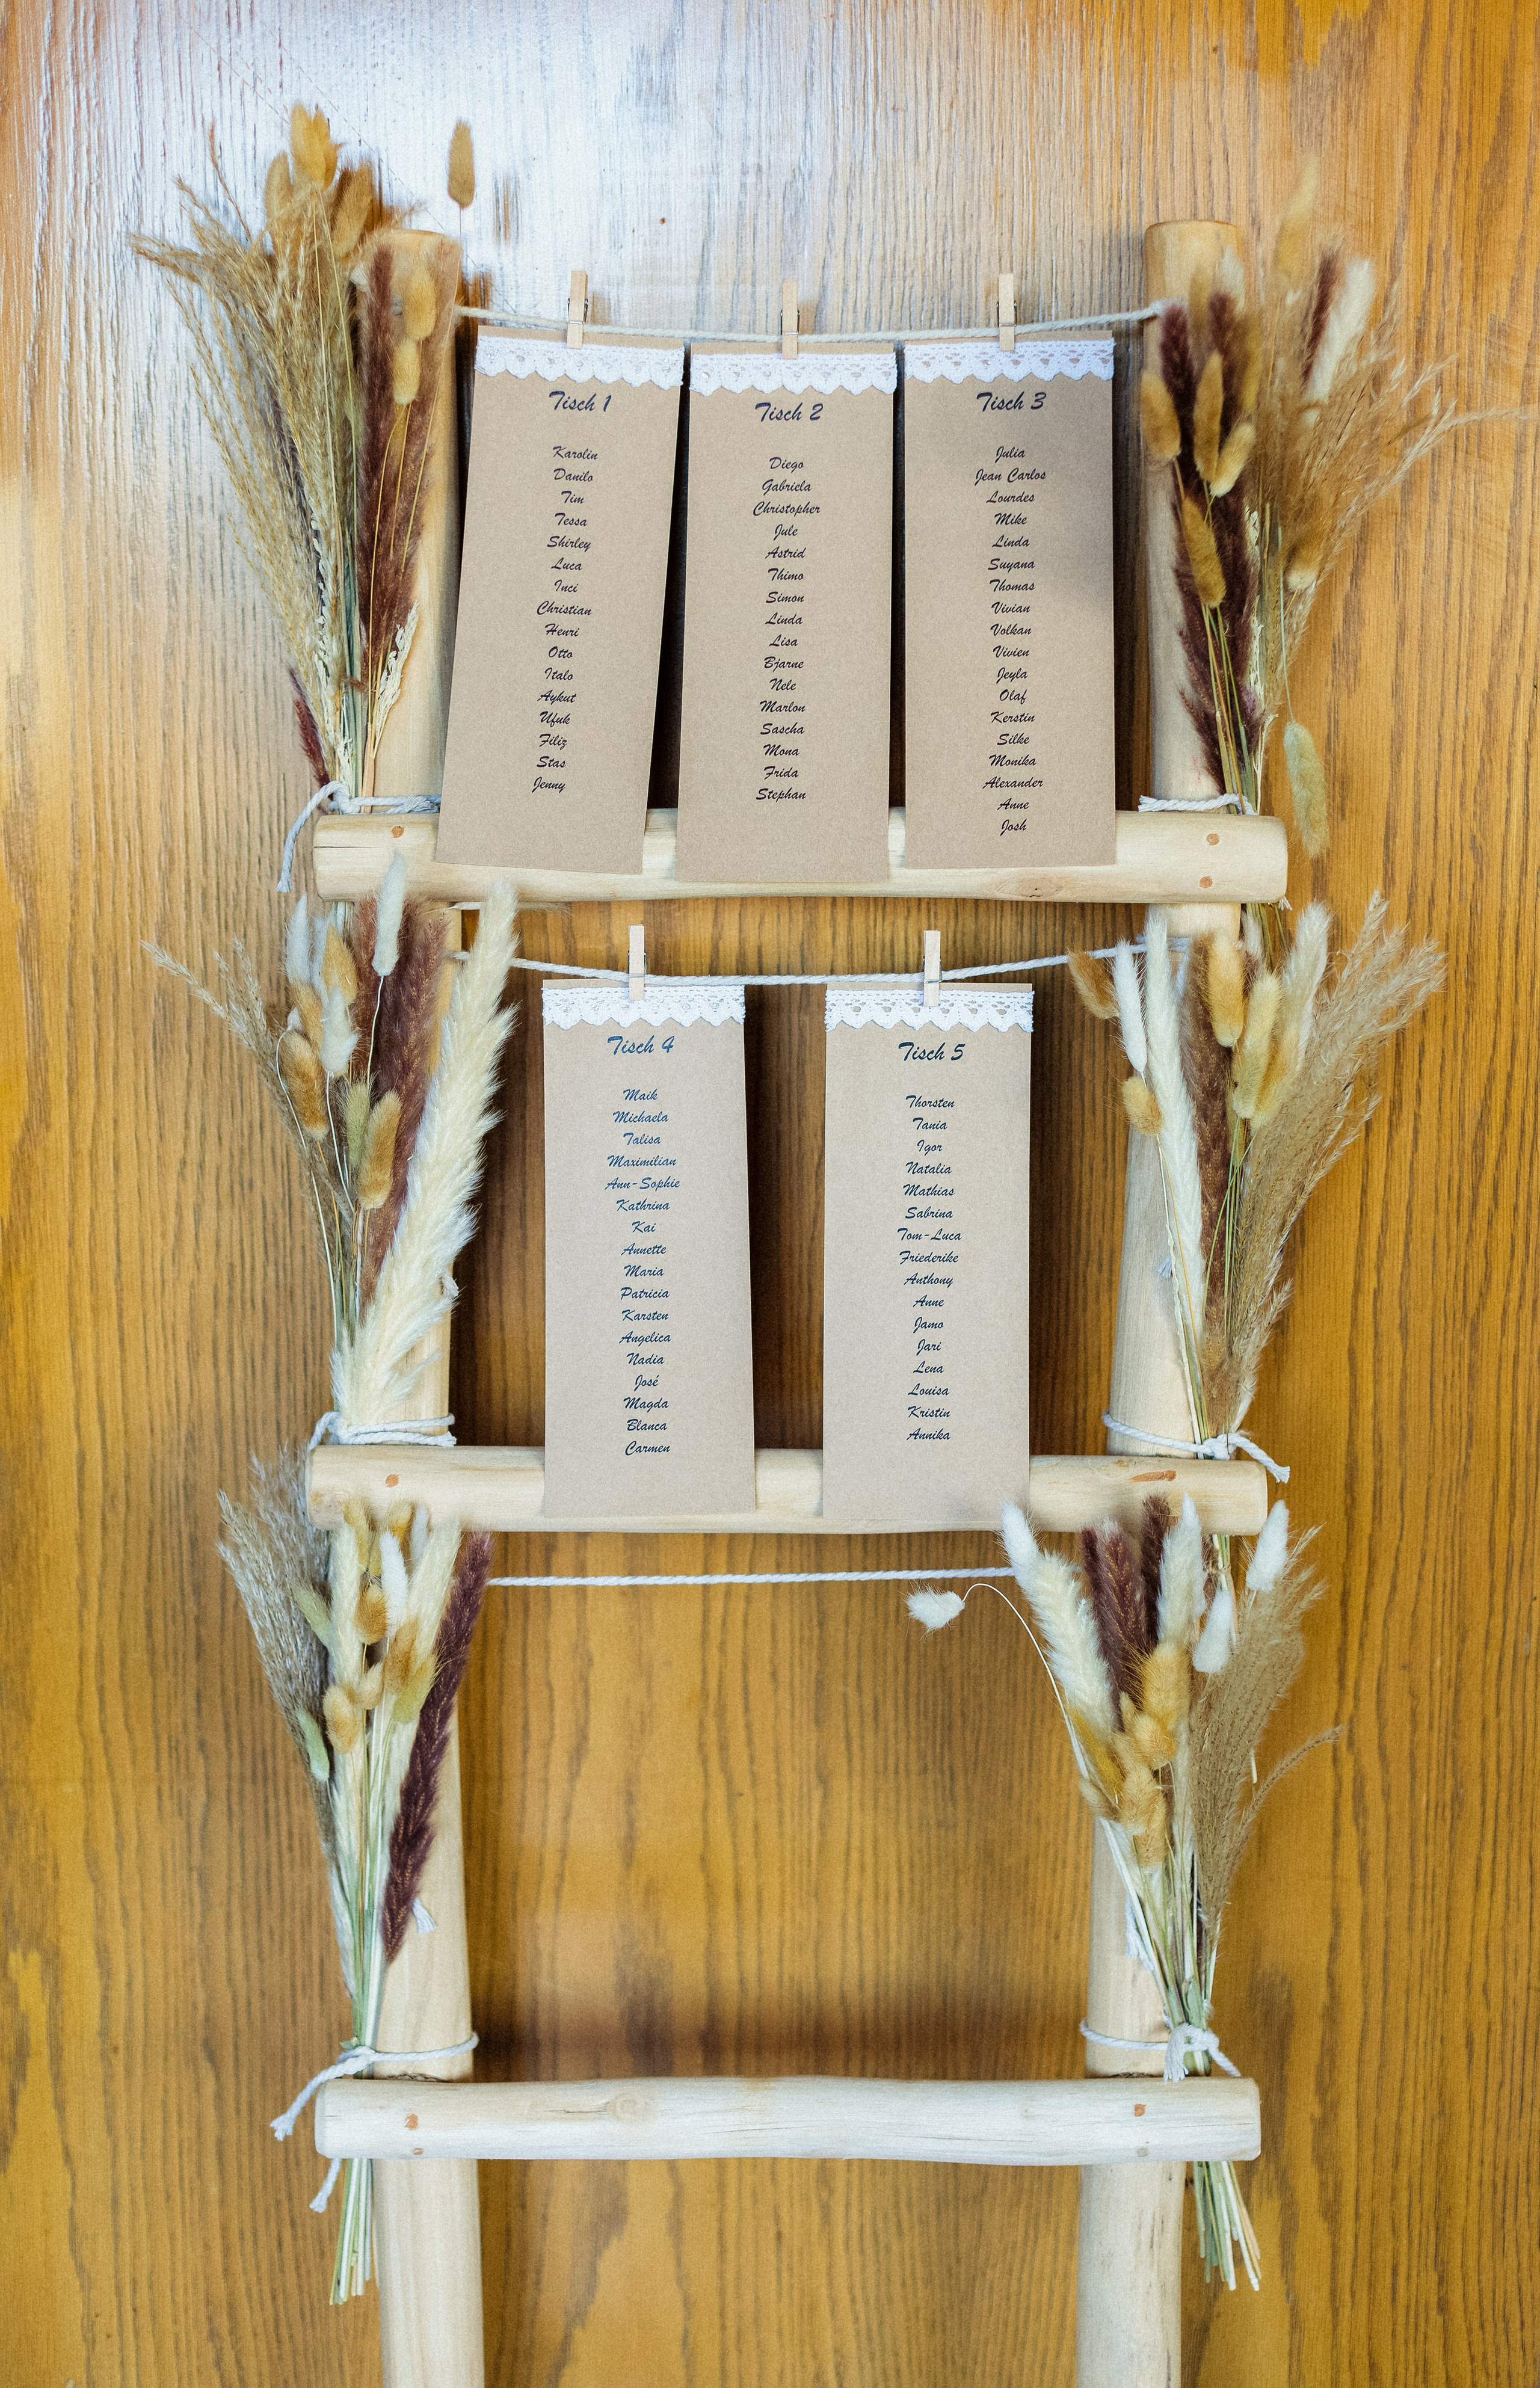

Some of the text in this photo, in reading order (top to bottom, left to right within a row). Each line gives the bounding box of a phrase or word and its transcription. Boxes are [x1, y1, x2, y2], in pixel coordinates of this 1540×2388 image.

[549, 390, 612, 413] Tisch 1
[976, 390, 1047, 413] Tisch 3
[754, 401, 824, 423] Tisch 2
[552, 445, 599, 461] Karolin
[994, 445, 1026, 464] Julia
[769, 456, 804, 474] Diego
[553, 467, 593, 482] Danilo
[974, 467, 1047, 487] Jean Carlos
[762, 478, 812, 496] Gabriela
[561, 490, 585, 505] Tim
[985, 490, 1035, 504] Lourdes
[753, 500, 821, 517] Christopher
[554, 512, 588, 527] Tessa
[994, 512, 1027, 526] Mike
[773, 523, 798, 541] Jule
[546, 535, 591, 553] Shirley
[991, 534, 1030, 548] Linda
[765, 546, 807, 559] Astrid
[550, 556, 583, 571] Luca
[987, 558, 1036, 573] Suyana
[767, 567, 805, 582] Thimo
[553, 579, 578, 593] Inci
[989, 579, 1036, 592] Thomas
[765, 591, 805, 604] Simon
[536, 600, 593, 616] Christian
[991, 601, 1030, 615] Vivian
[765, 612, 804, 626] Linda
[544, 623, 579, 637] Henri
[990, 623, 1032, 637] Volkan
[768, 633, 799, 647] Lisa
[548, 645, 573, 659] Otto
[992, 645, 1030, 659] Vivien
[763, 656, 804, 673] Bjarne
[544, 667, 574, 681] Italo
[996, 666, 1029, 685] Jeyla
[769, 677, 796, 692] Nele
[537, 689, 577, 706] Aykut
[999, 688, 1027, 706] Olaf
[759, 700, 806, 713] Marlon
[539, 710, 571, 728] Ufuk
[990, 710, 1036, 724] Kerstin
[760, 721, 805, 736] Sascha
[538, 733, 568, 751] Filiz
[996, 732, 1030, 746] Silke
[763, 743, 800, 757] Mona
[536, 755, 567, 768] Stas
[988, 754, 1037, 767] Monika
[763, 765, 799, 781] Frida
[531, 776, 566, 794] Jenny
[982, 775, 1044, 790] Alexander
[755, 787, 807, 803] Stephan
[996, 797, 1030, 811] Anne
[999, 818, 1027, 837] Josh
[607, 1035, 675, 1056] Tisch 4
[898, 1041, 966, 1062] Tisch 5
[623, 1088, 658, 1101] Maik
[905, 1095, 955, 1109] Thorsten
[612, 1110, 670, 1124] Michaela
[912, 1116, 948, 1131] Tania
[623, 1132, 662, 1146] Talisa
[916, 1139, 943, 1157] Igor
[607, 1154, 677, 1168] Maximilian
[905, 1161, 952, 1175] Natalia
[604, 1175, 680, 1192] Ann-Sophie
[902, 1183, 955, 1197] Mathias
[616, 1198, 671, 1212] Kathrina
[905, 1205, 954, 1219] Sabrina
[631, 1220, 656, 1234] Kai
[897, 1227, 962, 1242] Tom-Luca
[620, 1242, 667, 1256] Annette
[899, 1250, 959, 1265] Friederike
[623, 1264, 665, 1278] Maria
[903, 1272, 953, 1289] Anthony
[620, 1286, 670, 1300] Patricia
[912, 1294, 945, 1308] Anne
[621, 1309, 669, 1322] Karsten
[913, 1316, 944, 1334] Jamo
[618, 1330, 672, 1347] Angelica
[916, 1338, 941, 1356] Jari
[626, 1352, 665, 1366] Nadia
[912, 1360, 944, 1374] Lena
[633, 1374, 660, 1392] José
[907, 1382, 950, 1396] Louisa
[623, 1396, 670, 1414] Magda
[907, 1405, 951, 1418] Kristin
[626, 1418, 668, 1432] Blanca
[906, 1427, 951, 1441] Annika
[624, 1440, 671, 1456] Carmen
